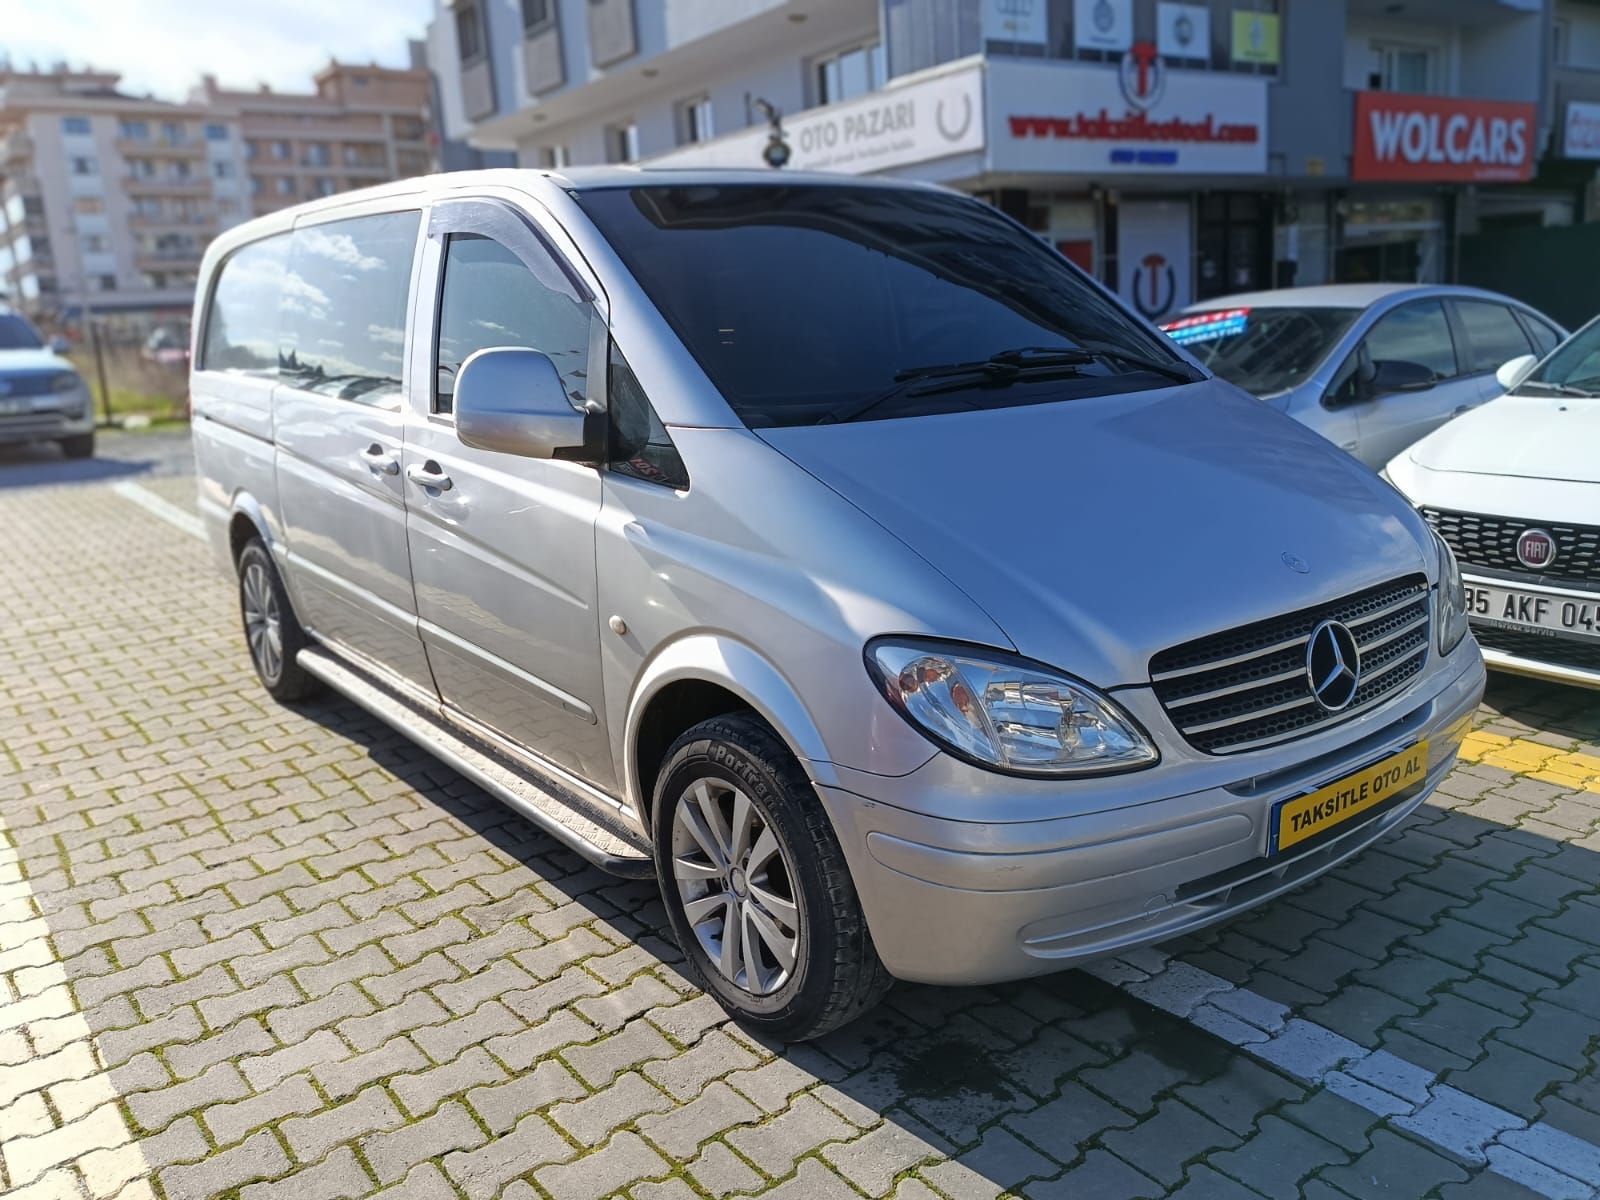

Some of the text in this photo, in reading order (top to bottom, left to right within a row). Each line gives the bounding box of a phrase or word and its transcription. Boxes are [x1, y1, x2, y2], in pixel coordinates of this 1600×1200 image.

[800, 100, 916, 153] OTO PAZARI
[1369, 111, 1527, 165] WOLCARS
[1524, 541, 1548, 559] FIAT
[1502, 593, 1549, 622] AKF
[1291, 756, 1420, 832] TAKSİTLE OTO AL
